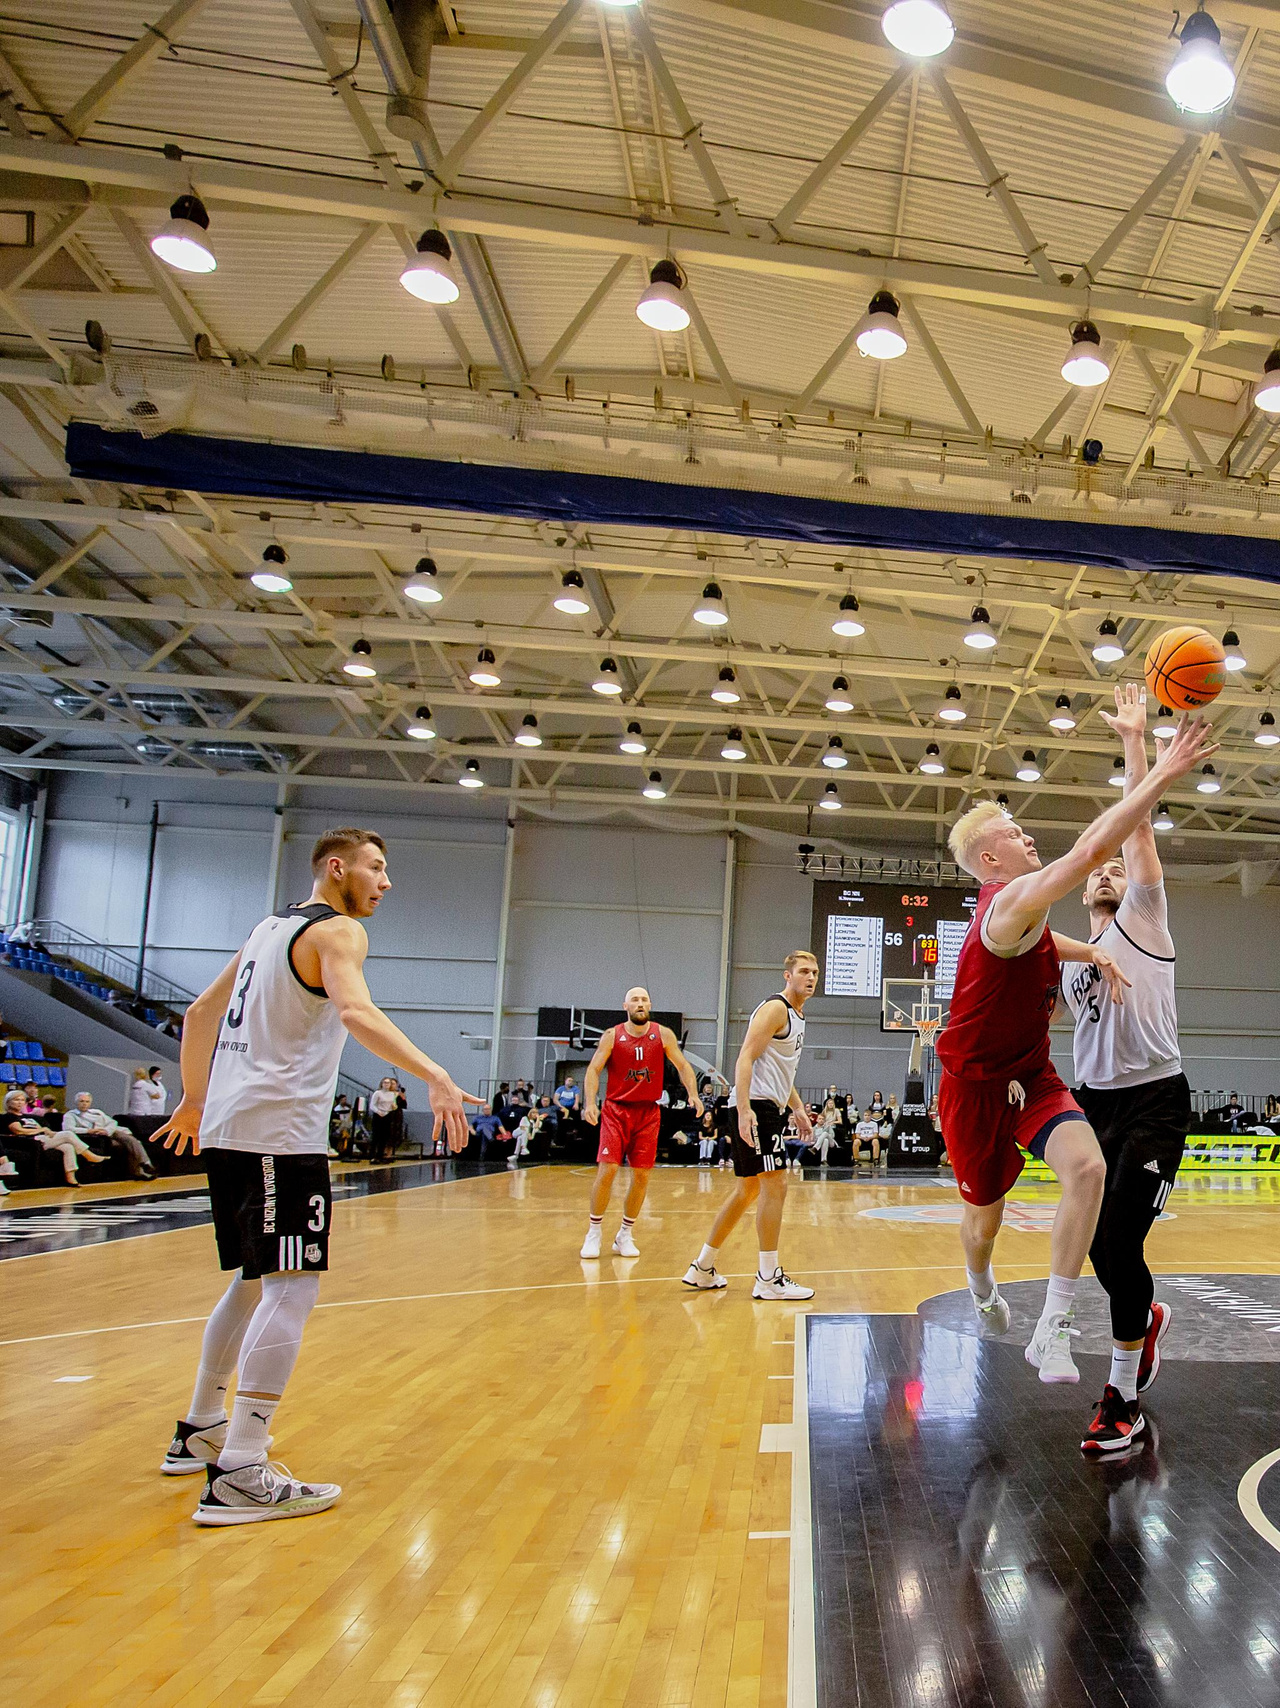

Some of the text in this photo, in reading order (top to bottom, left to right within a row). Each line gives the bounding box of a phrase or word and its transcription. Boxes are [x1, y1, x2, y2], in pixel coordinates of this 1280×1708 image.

[901, 894, 929, 907] 6:32
[906, 916, 914, 927] 3
[884, 932, 903, 946] 56
[924, 948, 937, 961] 16
[1071, 963, 1103, 1007] BCN
[227, 960, 256, 1029] 3
[1088, 994, 1101, 1024] 5
[634, 1046, 644, 1061] 11
[261, 1155, 276, 1196] NOVGOROD
[308, 1194, 325, 1232] 3
[263, 1222, 276, 1234] BC
